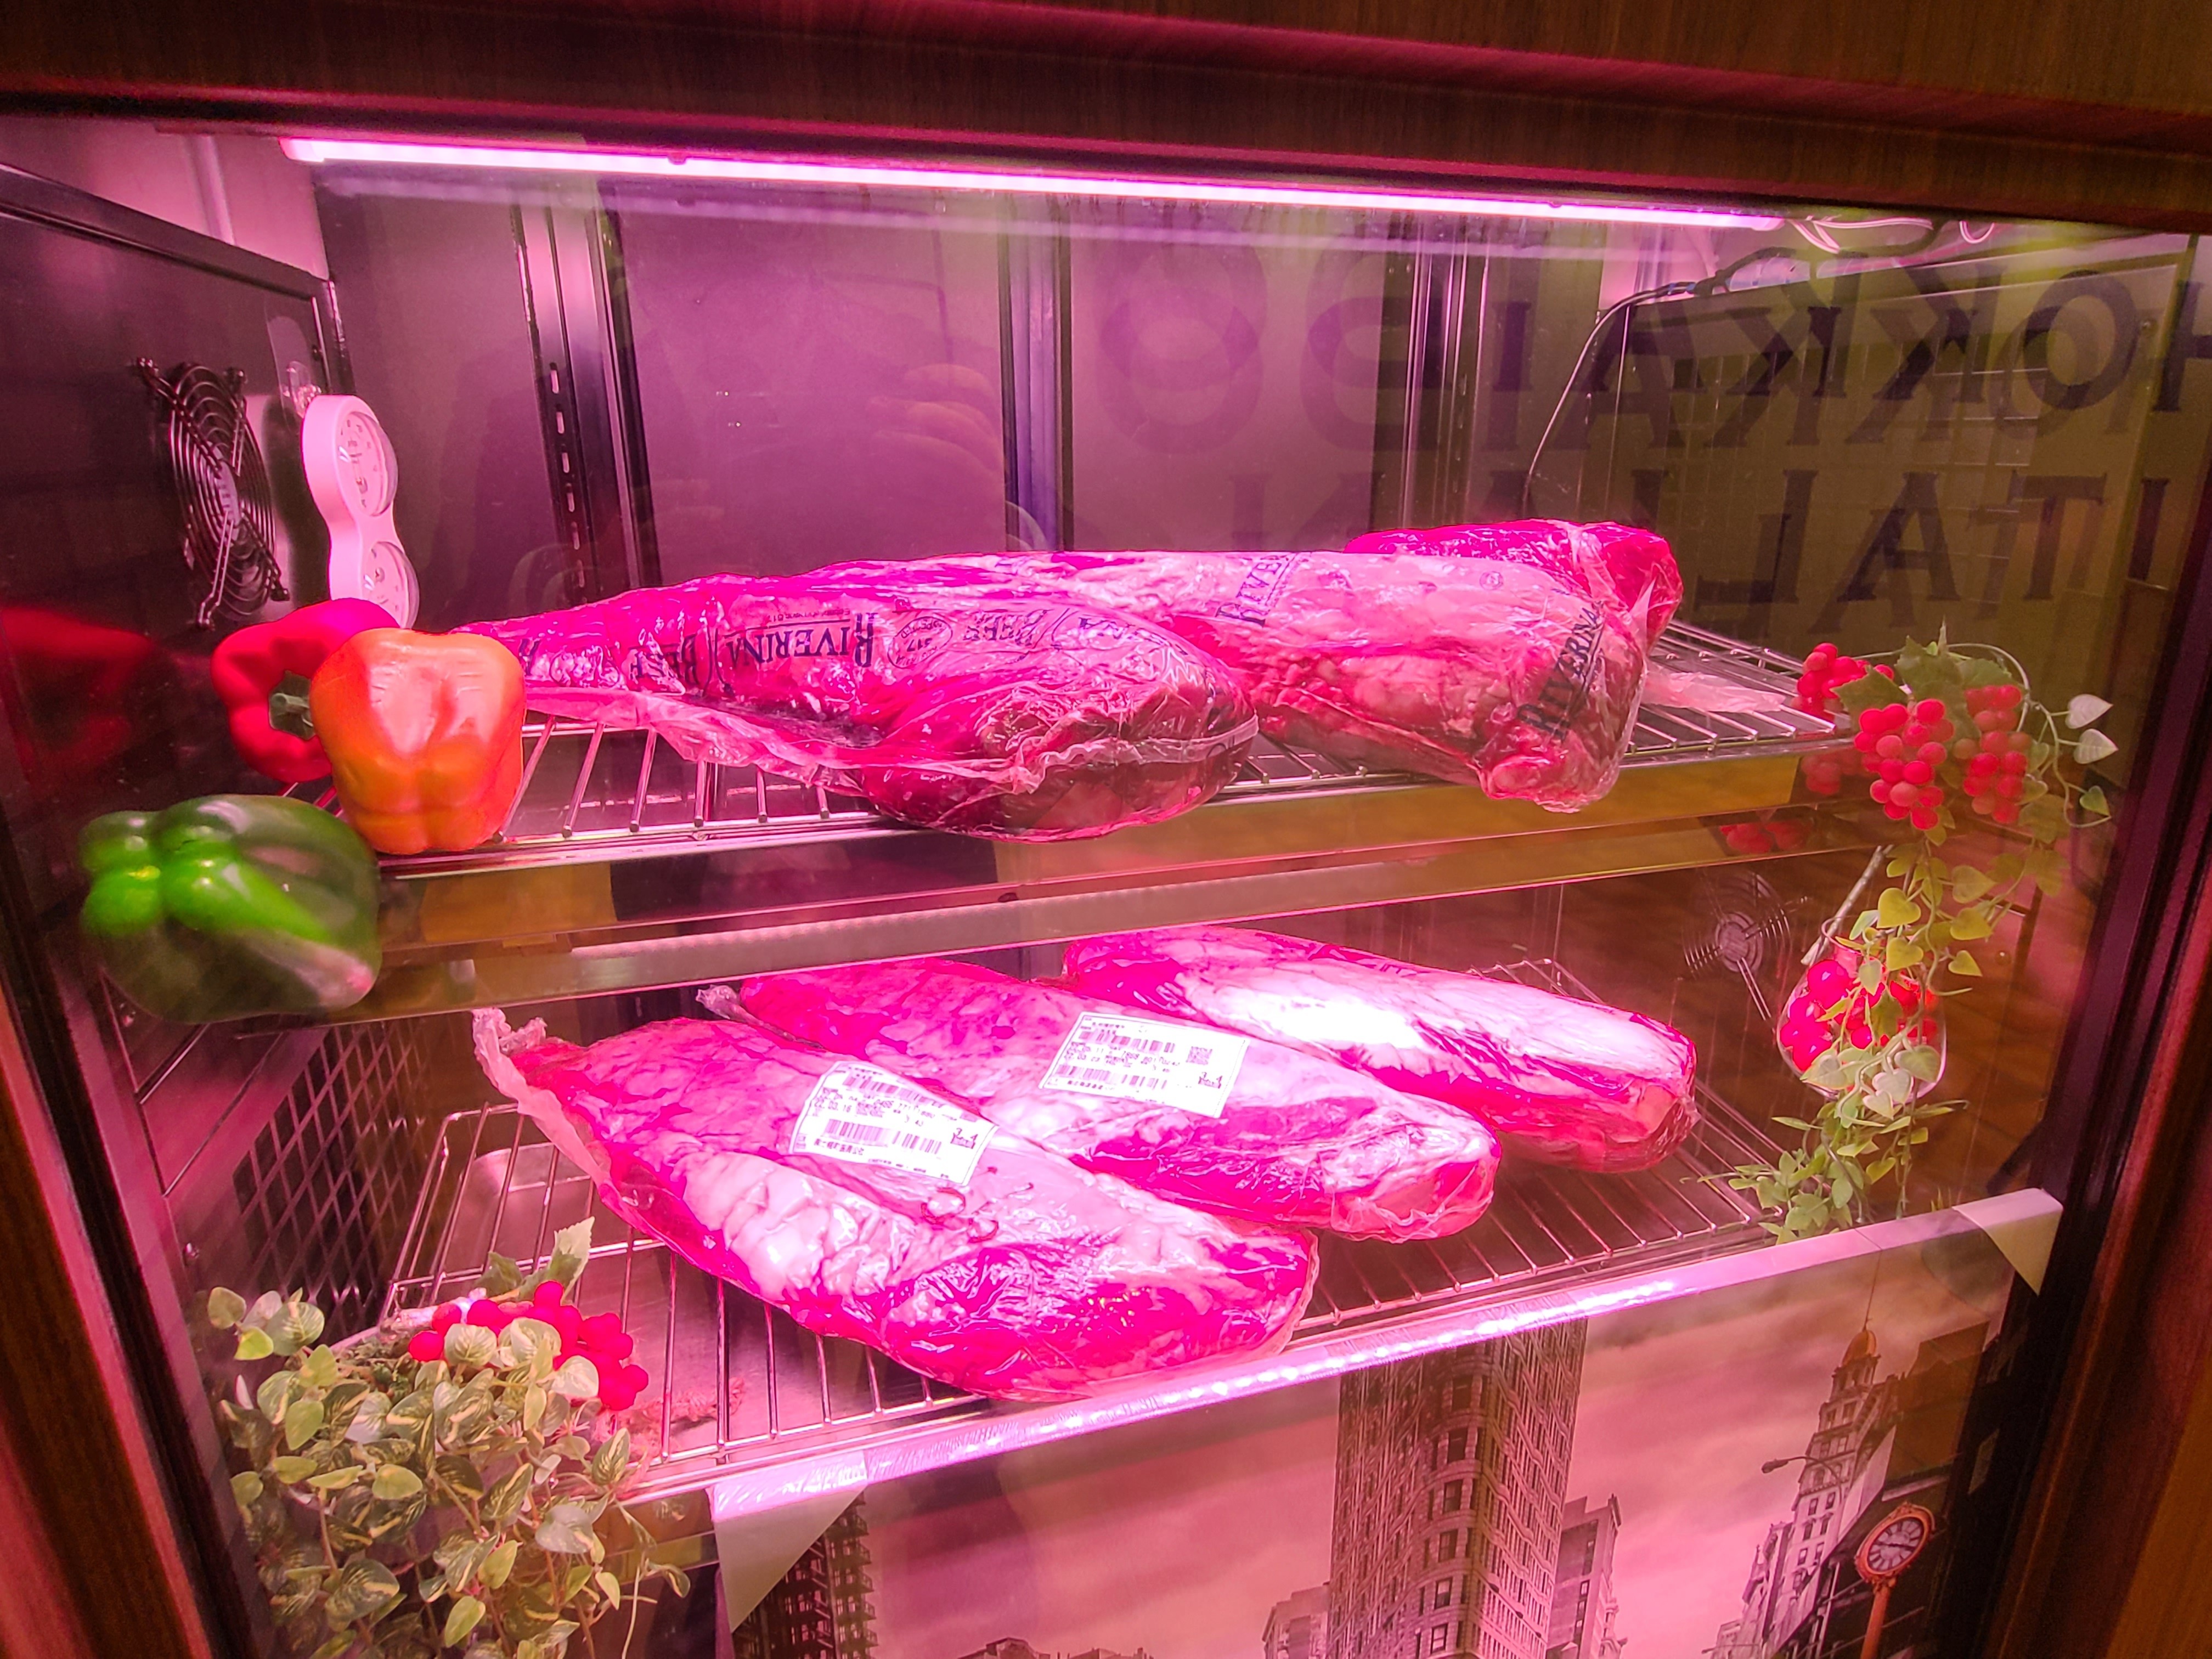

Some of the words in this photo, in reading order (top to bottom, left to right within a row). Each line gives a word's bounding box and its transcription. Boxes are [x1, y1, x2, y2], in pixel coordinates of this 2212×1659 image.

[725, 613, 875, 668] RIVERINA
[906, 637, 933, 652] 517
[1517, 600, 1605, 739] RIVERINA
